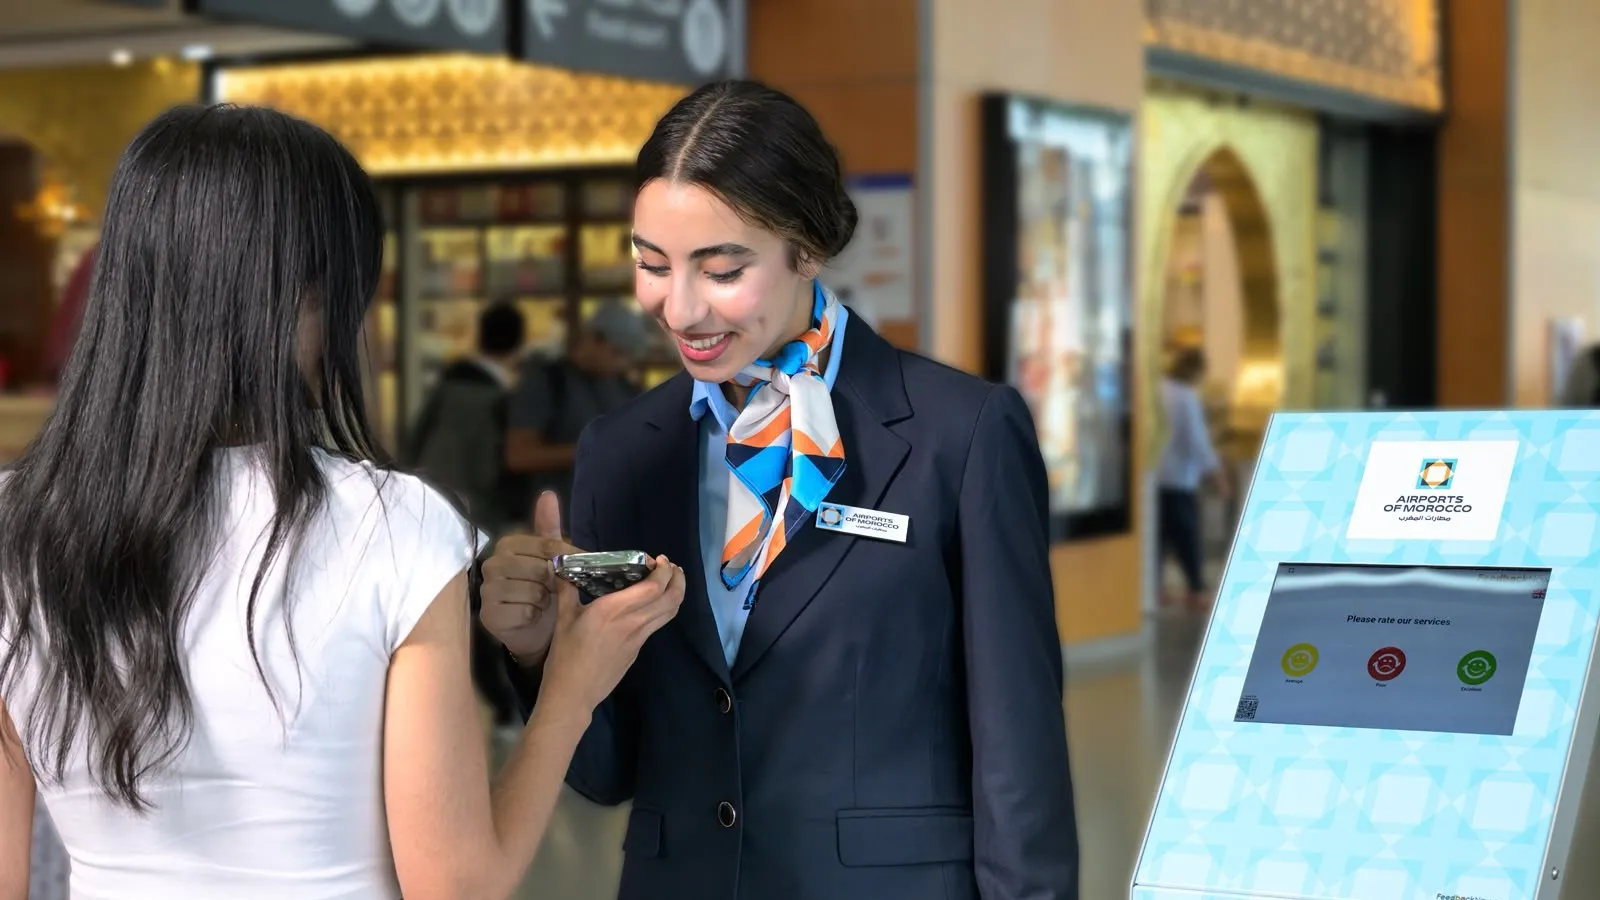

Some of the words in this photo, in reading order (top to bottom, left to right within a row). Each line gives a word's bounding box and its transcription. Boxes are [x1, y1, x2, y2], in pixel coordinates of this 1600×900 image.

[1396, 495, 1464, 504] AIRPORTS
[1383, 504, 1402, 512] OF
[1403, 504, 1472, 513] MOROCCO
[852, 513, 894, 523] AIRPORTS
[858, 519, 899, 529] MOROCCO
[1346, 614, 1376, 624] Please
[1377, 616, 1396, 624] rate
[1413, 617, 1451, 626] services
